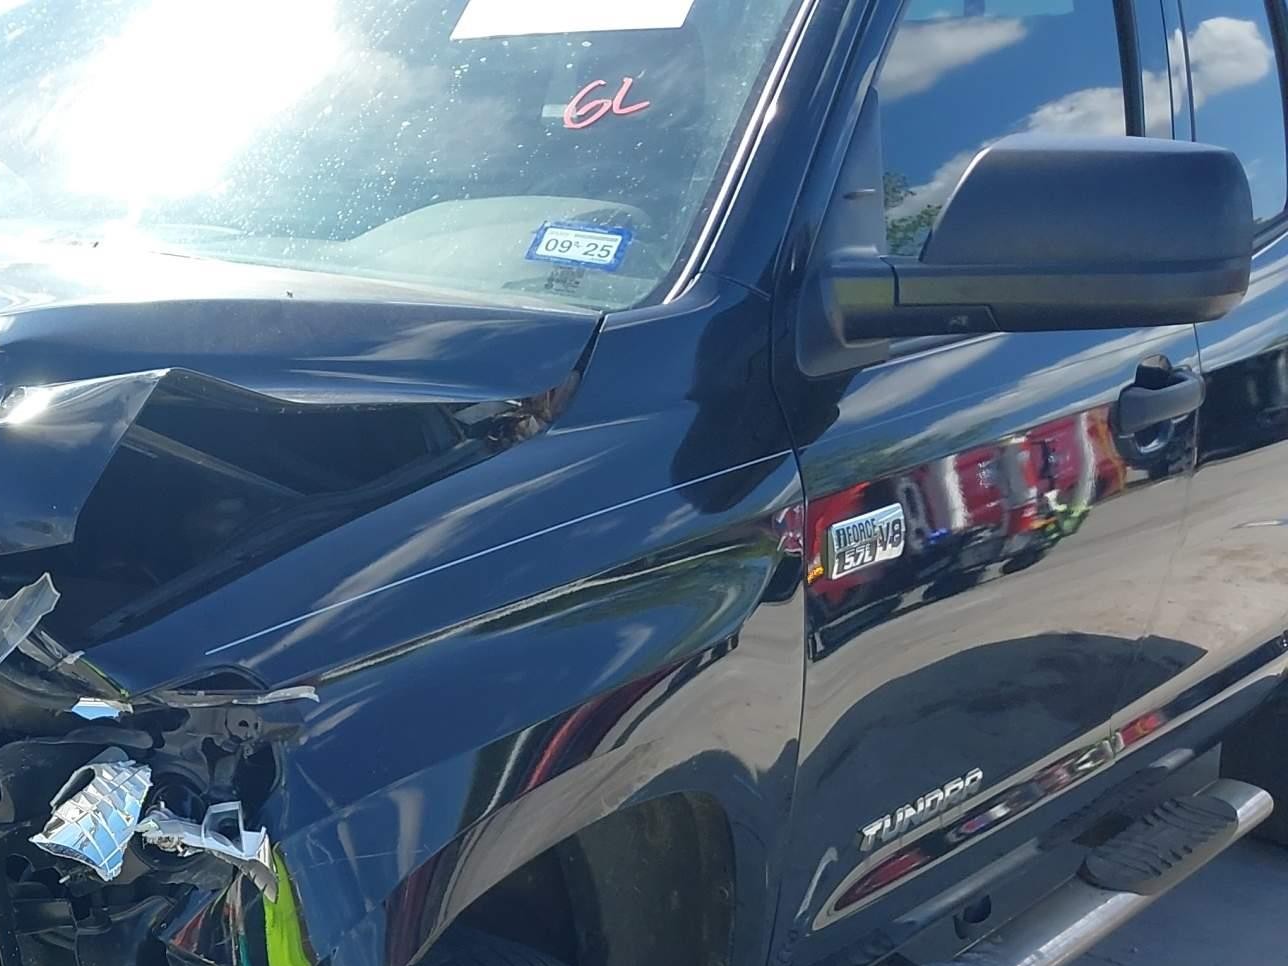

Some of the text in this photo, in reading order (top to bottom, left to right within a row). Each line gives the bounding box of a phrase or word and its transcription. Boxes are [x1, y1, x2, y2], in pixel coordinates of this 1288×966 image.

[544, 238, 614, 259] 09 25
[878, 518, 903, 551] V8
[859, 767, 984, 851] TUNDRA
